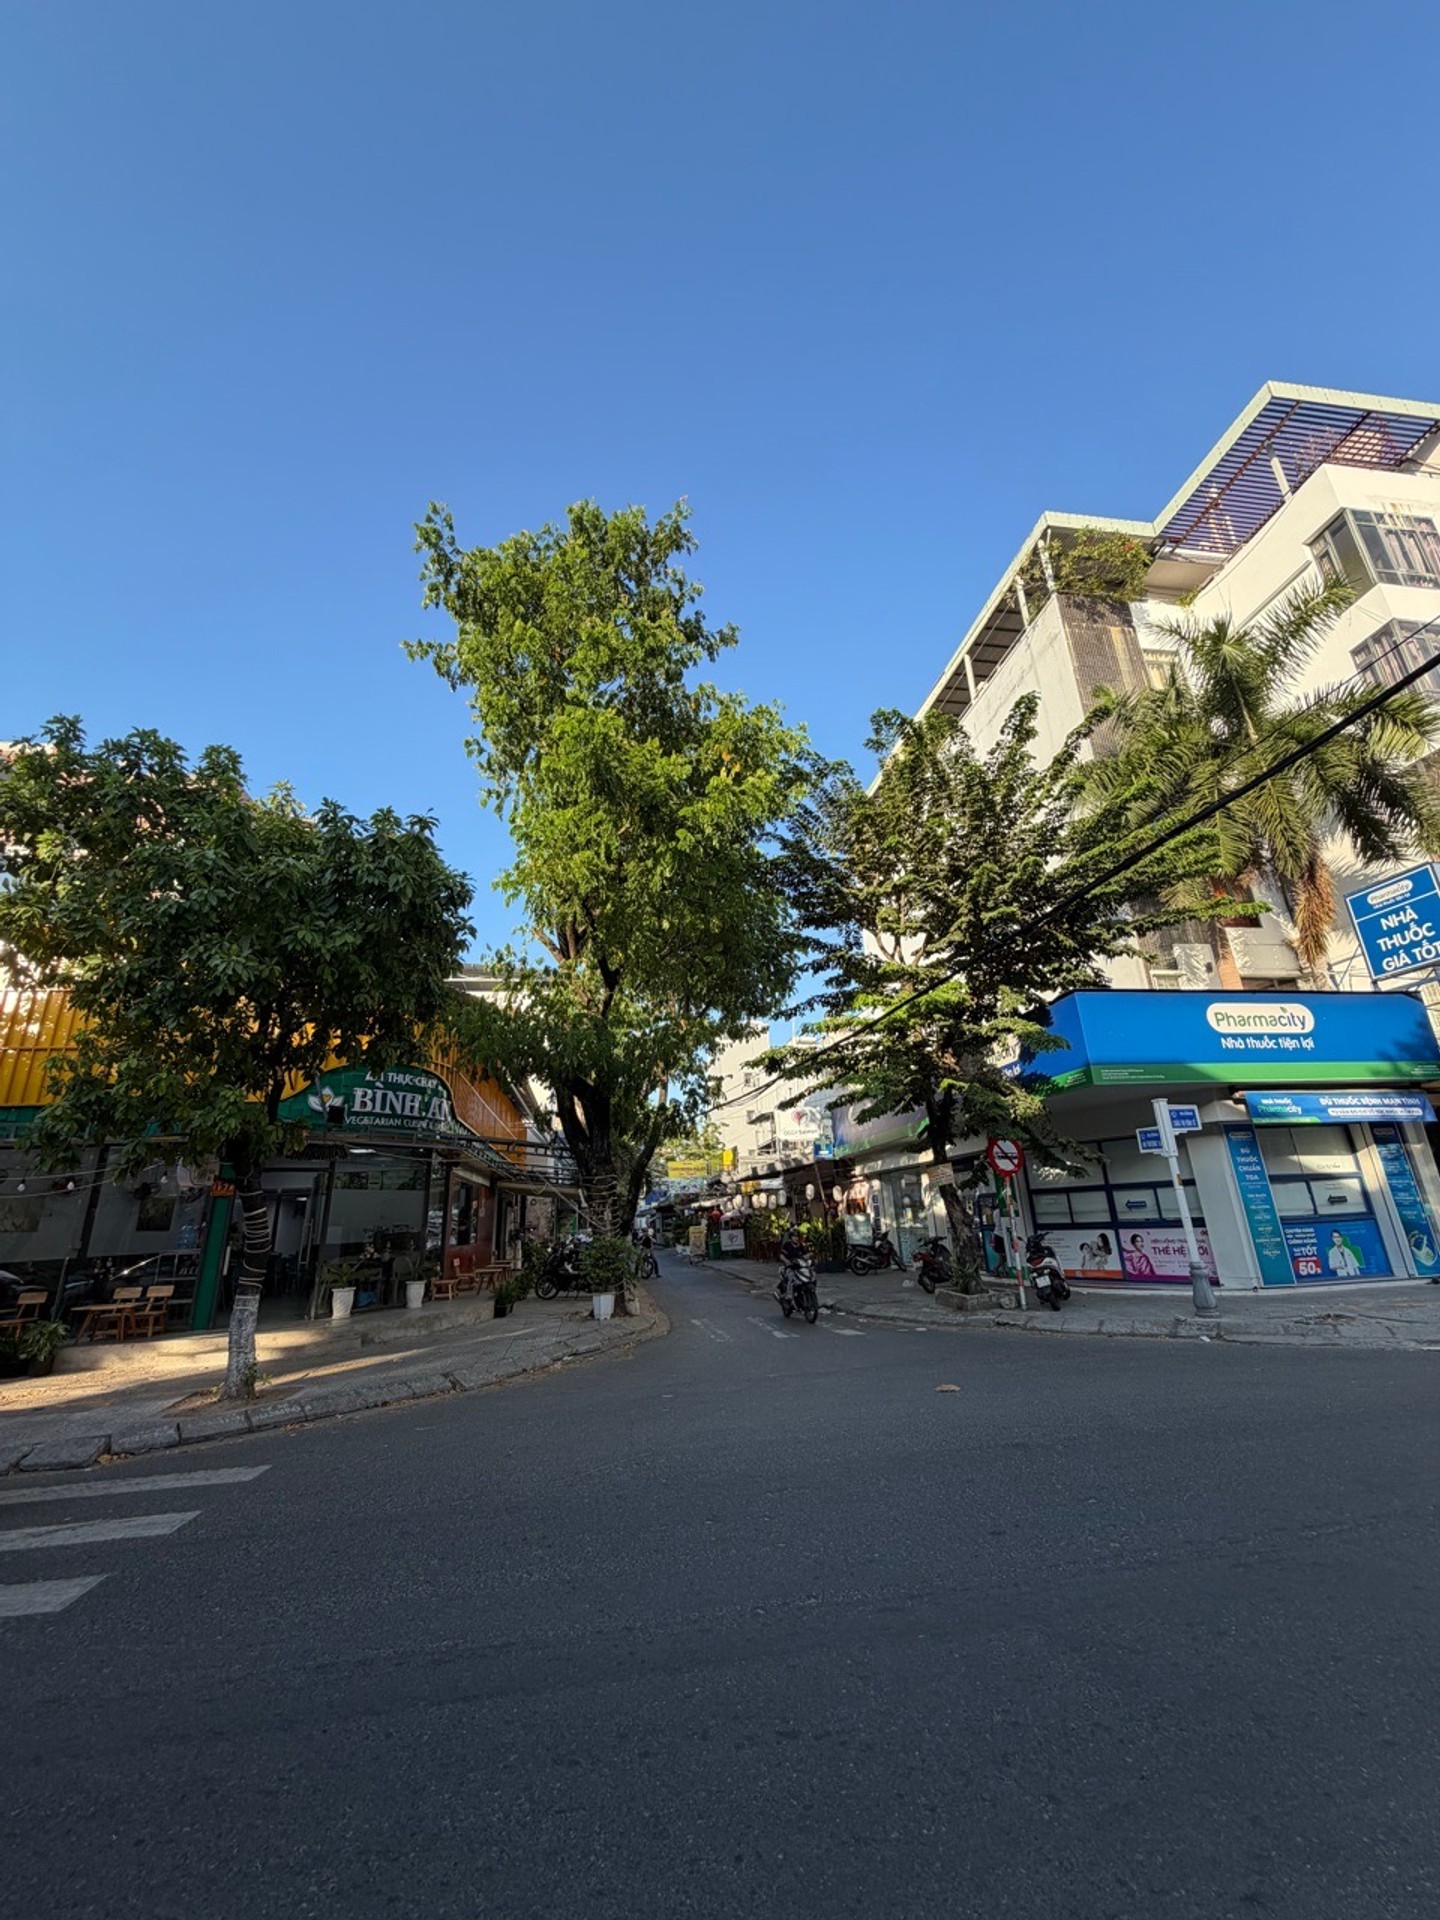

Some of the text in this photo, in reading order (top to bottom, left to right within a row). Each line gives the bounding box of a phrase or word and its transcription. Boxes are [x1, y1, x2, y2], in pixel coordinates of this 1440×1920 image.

[1380, 905, 1418, 931] NHÀ
[1376, 922, 1436, 952] THUỐC
[1382, 949, 1412, 971] GIÁ
[1214, 1009, 1306, 1030] Pharmacity
[1220, 1036, 1244, 1049] Nhà
[1246, 1035, 1278, 1049] thuốc
[1278, 1036, 1300, 1051] tiện
[351, 1082, 422, 1117] BÌNH
[345, 1115, 401, 1127] VEGETARIAN
[1151, 1246, 1171, 1255] THẾ
[1172, 1245, 1187, 1258] HỆ
[1301, 1243, 1318, 1256] TỐT
